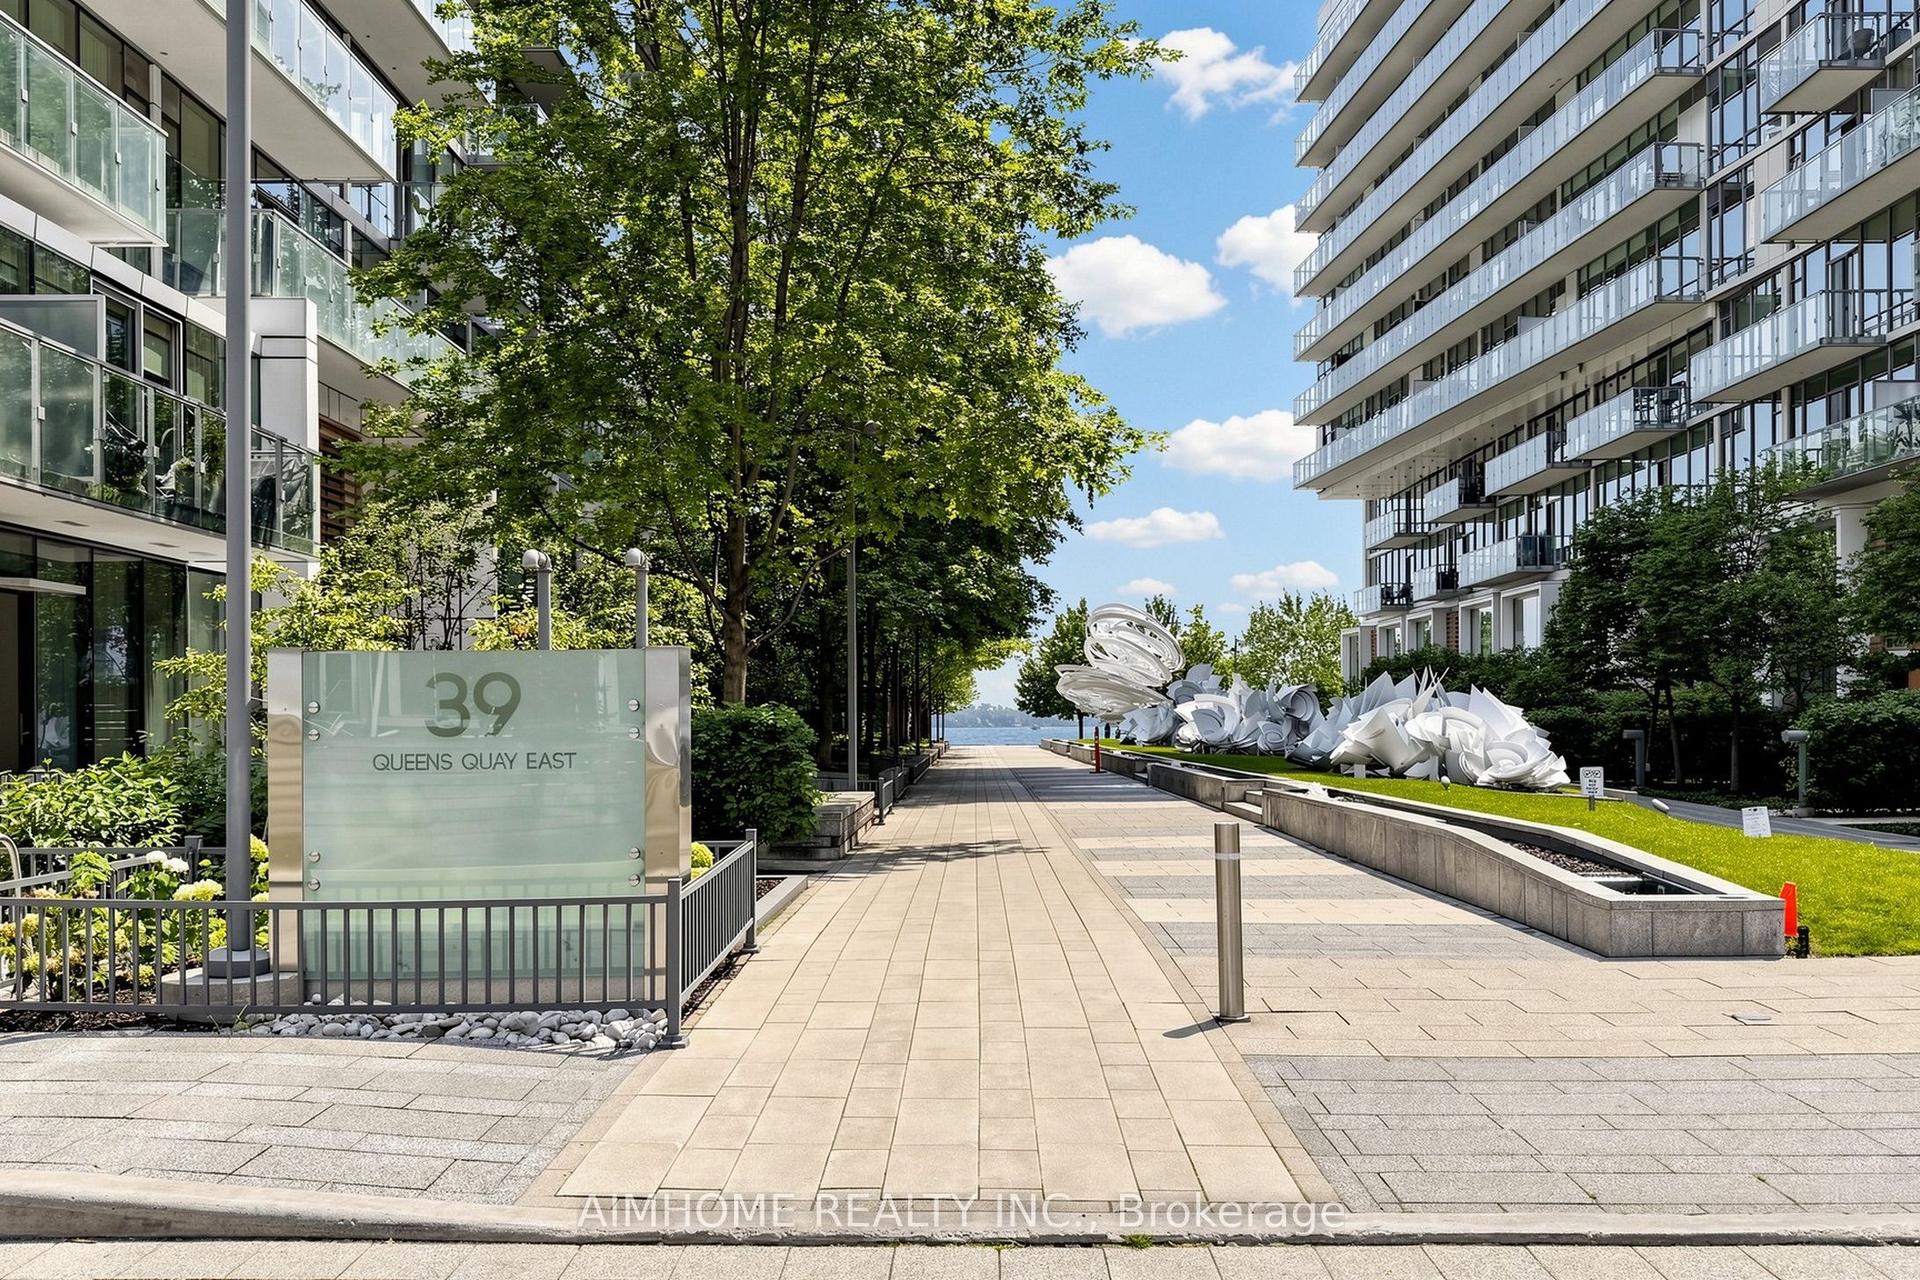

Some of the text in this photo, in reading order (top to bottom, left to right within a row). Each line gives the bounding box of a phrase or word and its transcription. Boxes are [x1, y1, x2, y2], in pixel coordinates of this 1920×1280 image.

[425, 672, 521, 737] 39
[373, 752, 577, 771] QUEENS QUAY EAST
